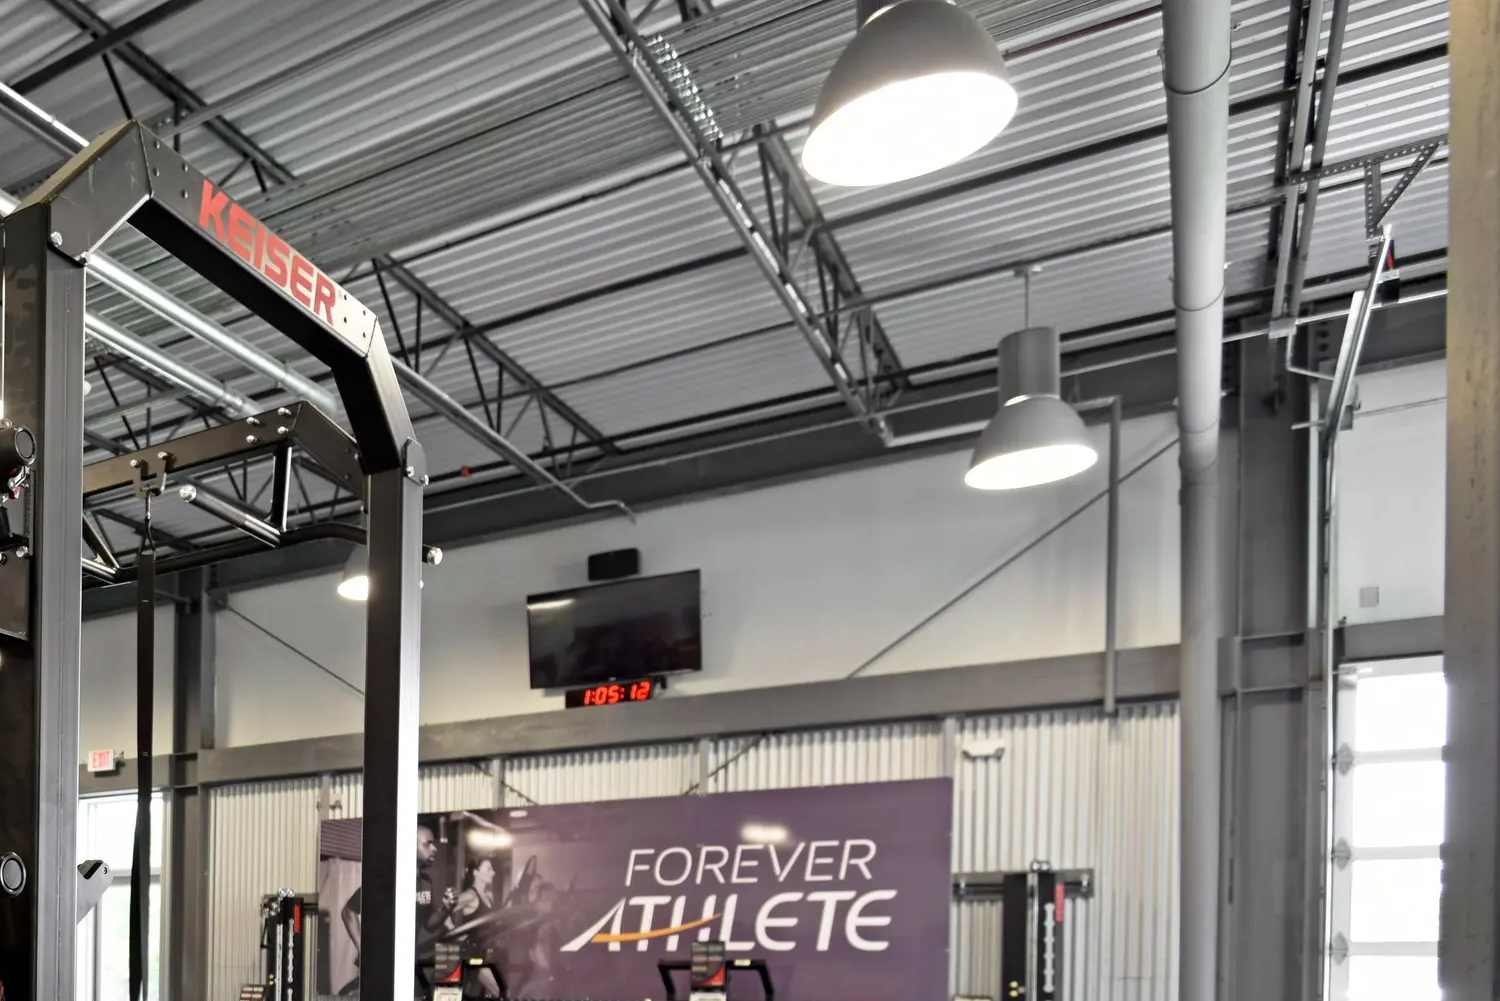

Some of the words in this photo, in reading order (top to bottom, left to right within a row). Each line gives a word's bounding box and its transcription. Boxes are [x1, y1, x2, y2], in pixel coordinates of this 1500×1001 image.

[198, 179, 336, 326] KEISER
[624, 838, 878, 888] FOREVER
[560, 889, 898, 953] ATHLETE
